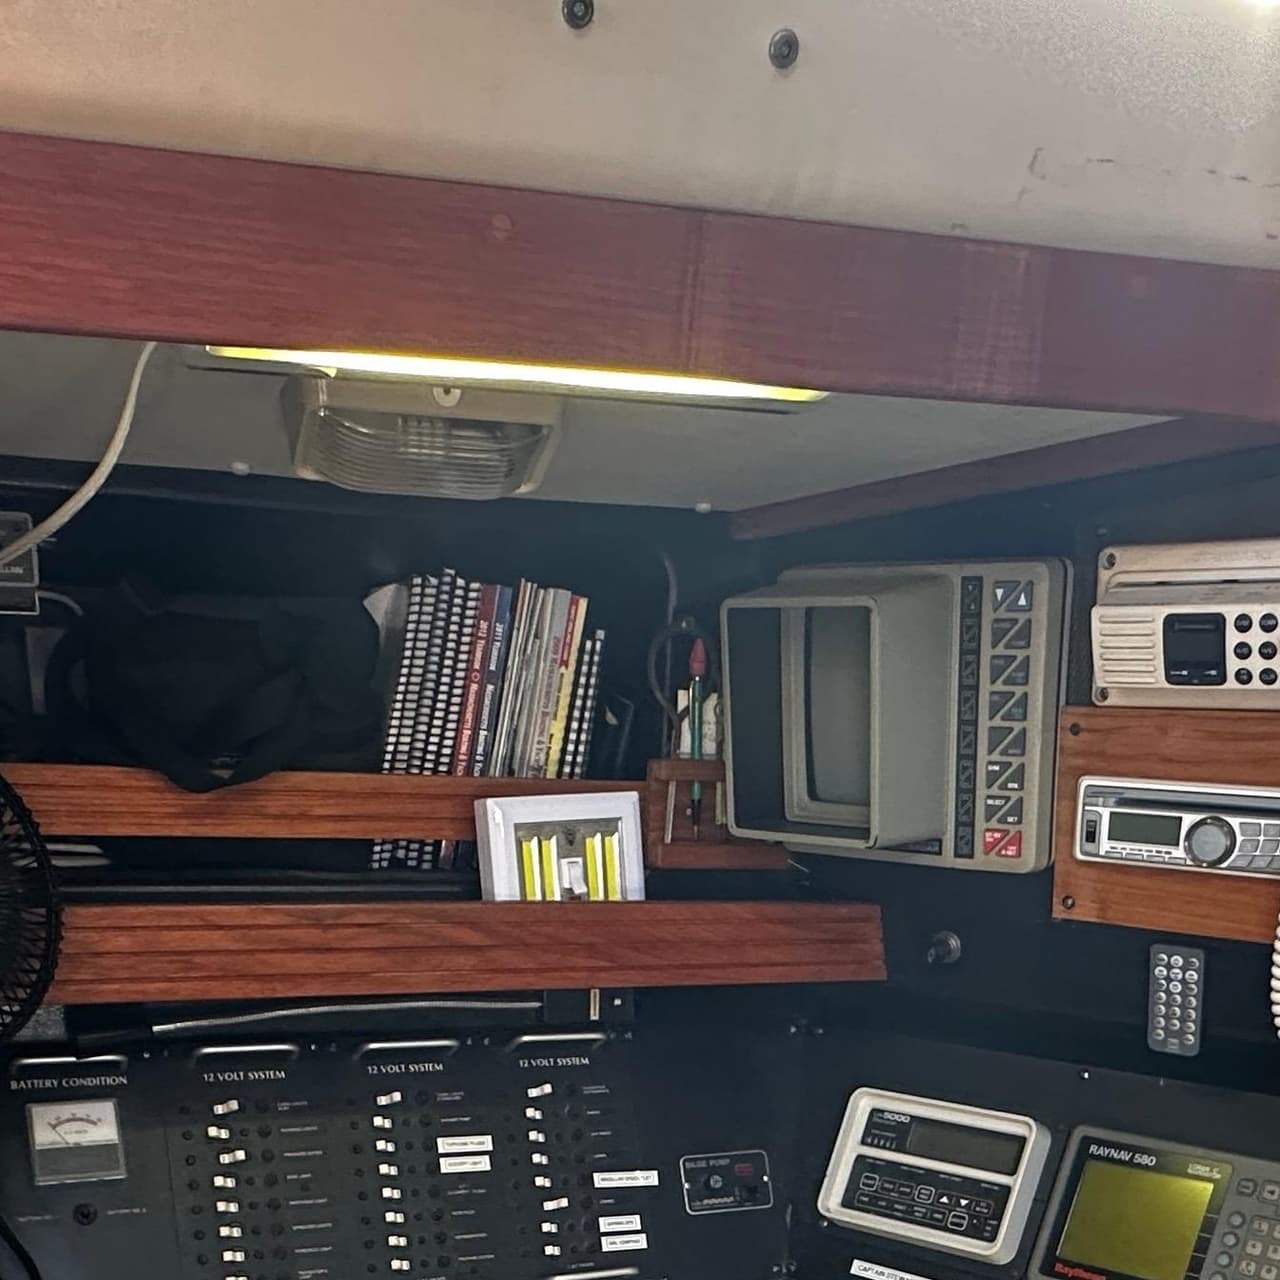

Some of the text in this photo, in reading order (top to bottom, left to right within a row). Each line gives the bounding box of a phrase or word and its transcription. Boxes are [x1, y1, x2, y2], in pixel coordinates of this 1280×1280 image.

[367, 1062, 444, 1075] 12 VOLT SYSTEM
[519, 1056, 590, 1068] 12 VOLT SYSTEM
[10, 1075, 128, 1091] BATTERY CONDITION
[202, 1070, 287, 1083] 12 VOLT SYSTEM
[884, 1111, 911, 1123] 5000
[1089, 1144, 1157, 1167] RAYNAV 580
